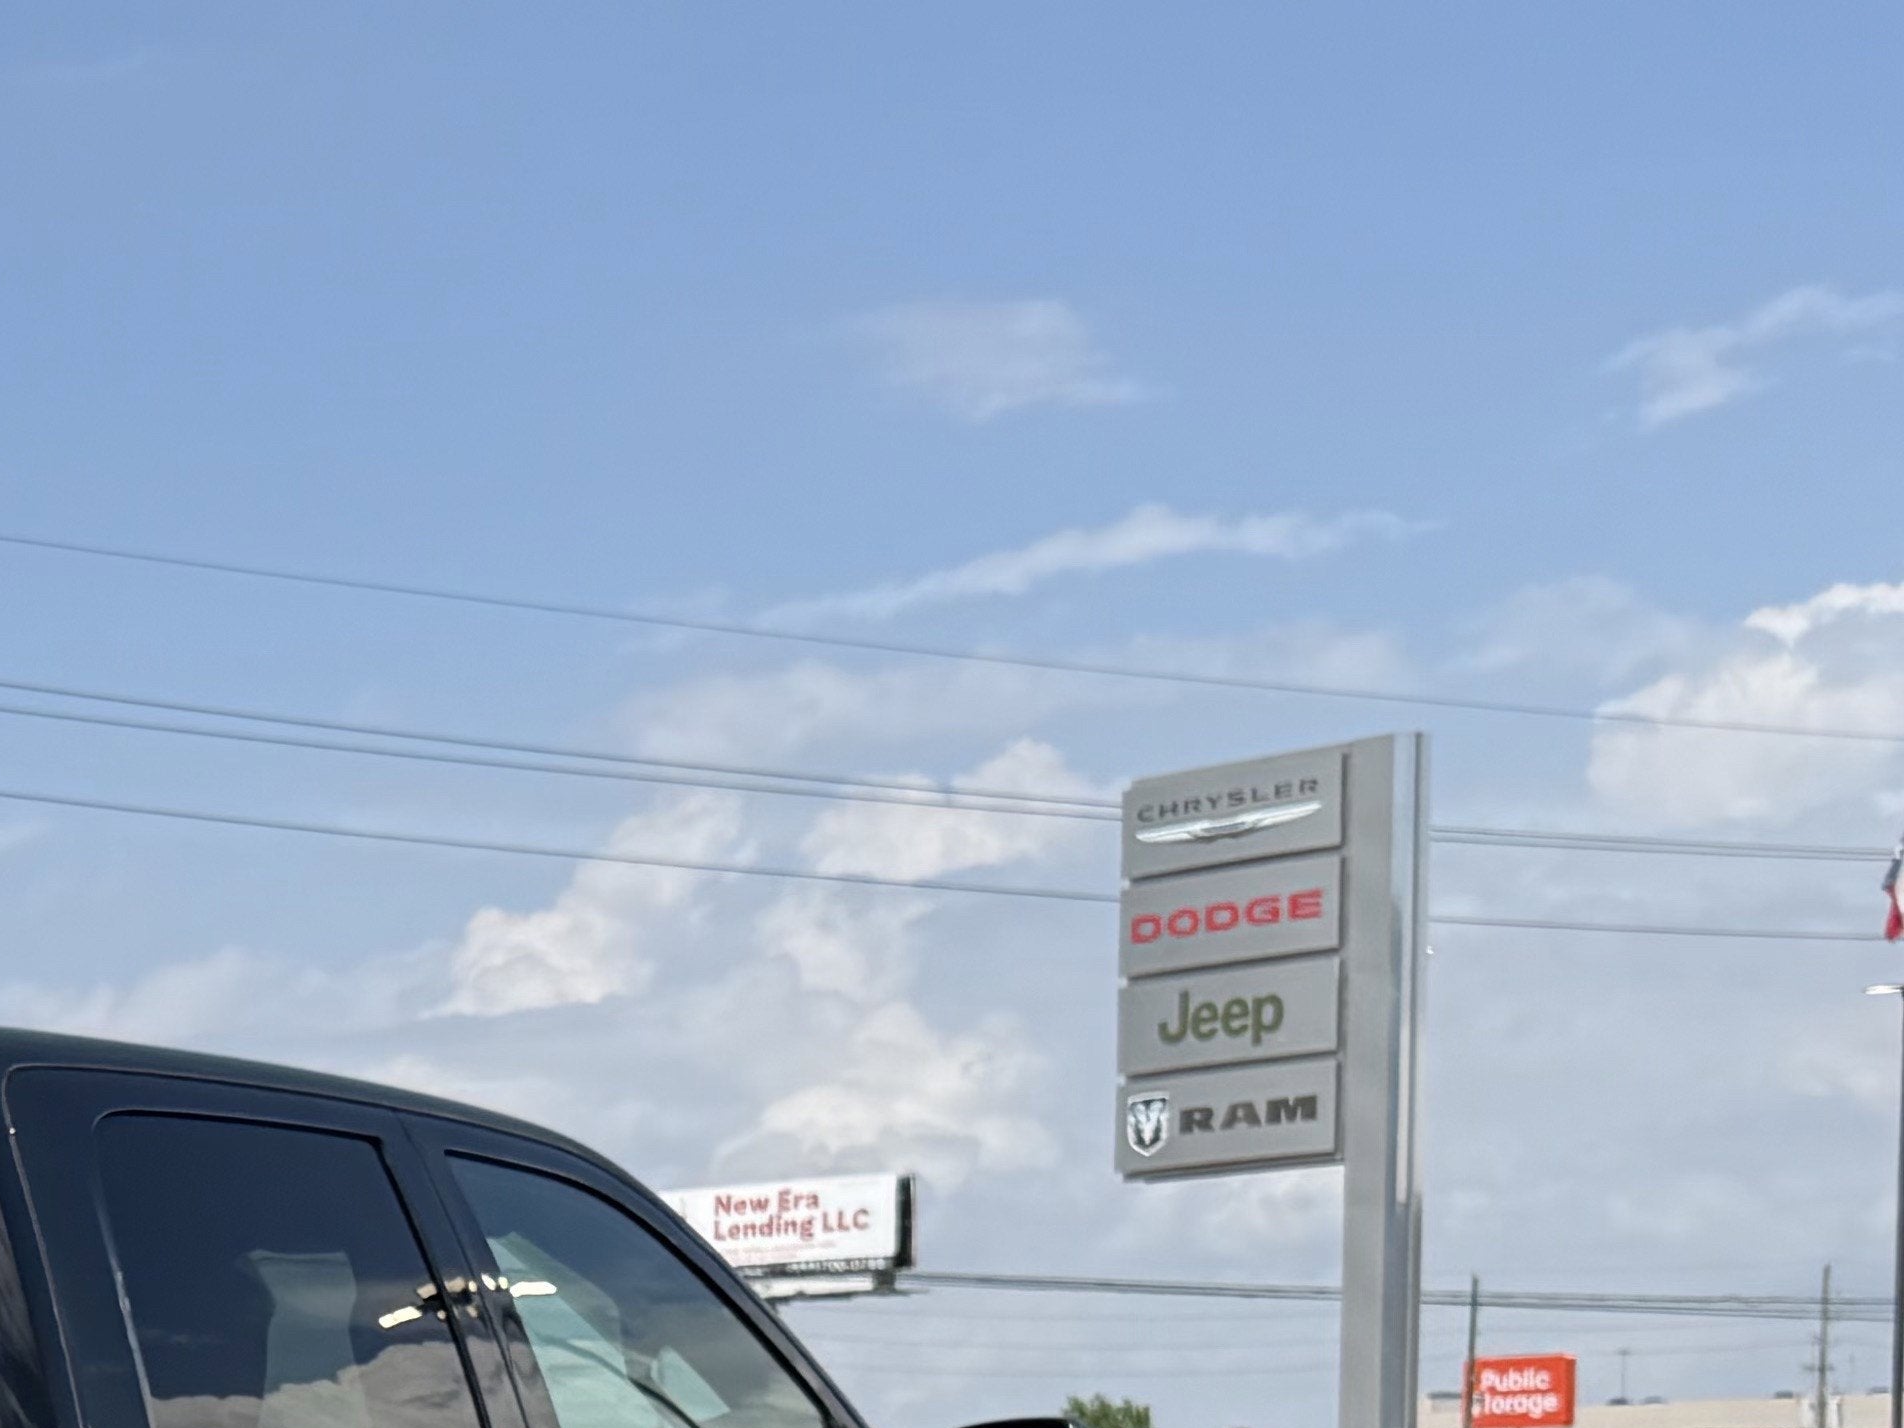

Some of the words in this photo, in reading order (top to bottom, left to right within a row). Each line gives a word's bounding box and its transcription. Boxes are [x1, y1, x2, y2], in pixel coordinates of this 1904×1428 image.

[1136, 777, 1320, 824] CHRYSLER
[1130, 887, 1324, 945] DODGE
[1157, 989, 1285, 1046] Jeep
[1178, 1093, 1319, 1136] RAM
[713, 1194, 770, 1217] New
[777, 1187, 820, 1213] Era
[713, 1213, 814, 1243] Lending
[821, 1208, 870, 1234] LLC
[1480, 1367, 1551, 1392] Public
